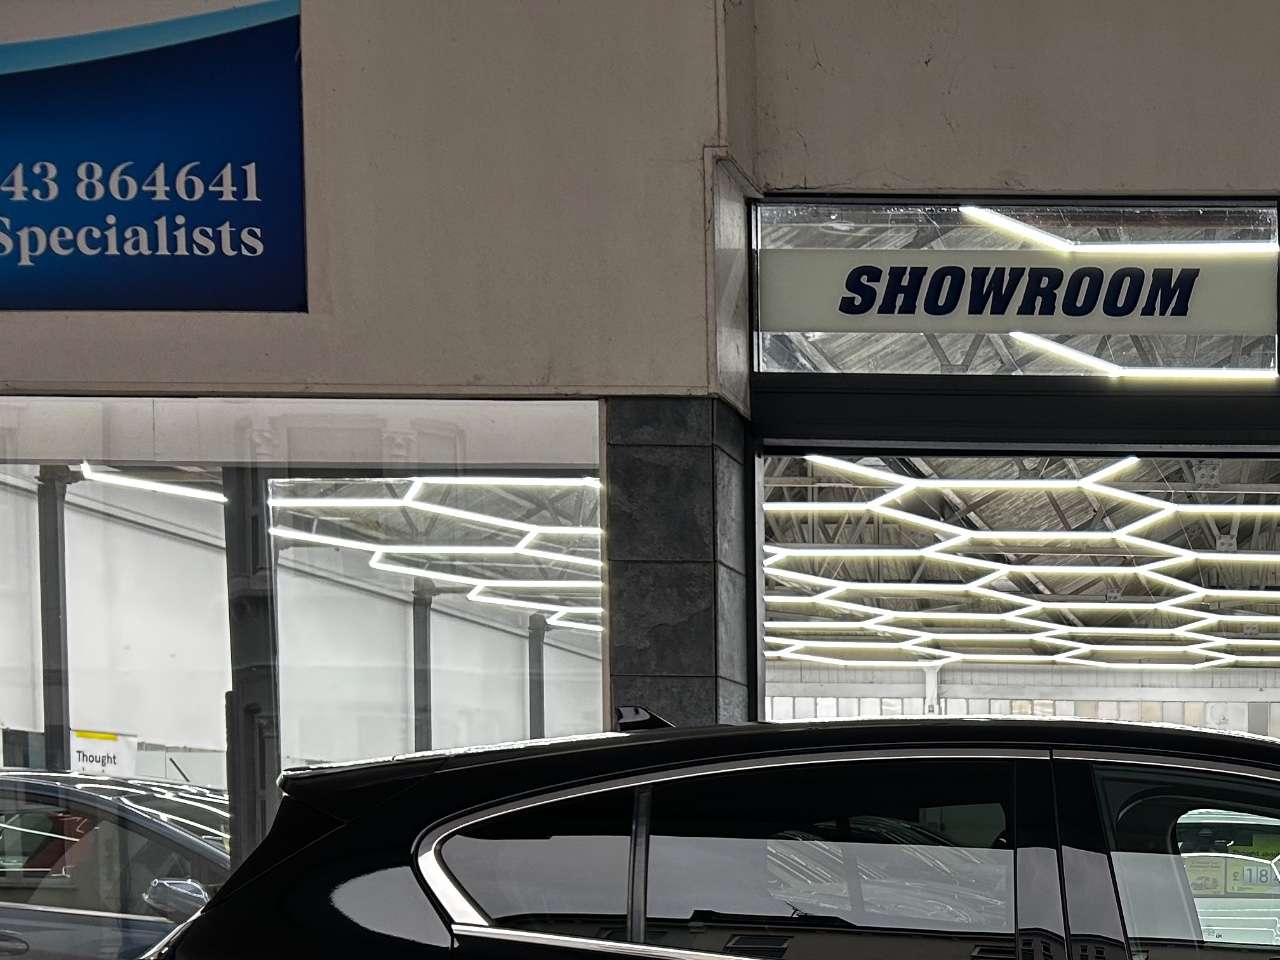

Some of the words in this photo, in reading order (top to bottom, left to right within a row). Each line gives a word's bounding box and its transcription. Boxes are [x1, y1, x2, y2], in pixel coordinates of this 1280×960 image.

[0, 161, 60, 202] 43
[75, 161, 263, 202] 864641
[0, 214, 265, 266] Specialists
[838, 264, 1201, 318] SHOWROOM
[76, 750, 117, 767] Thought
